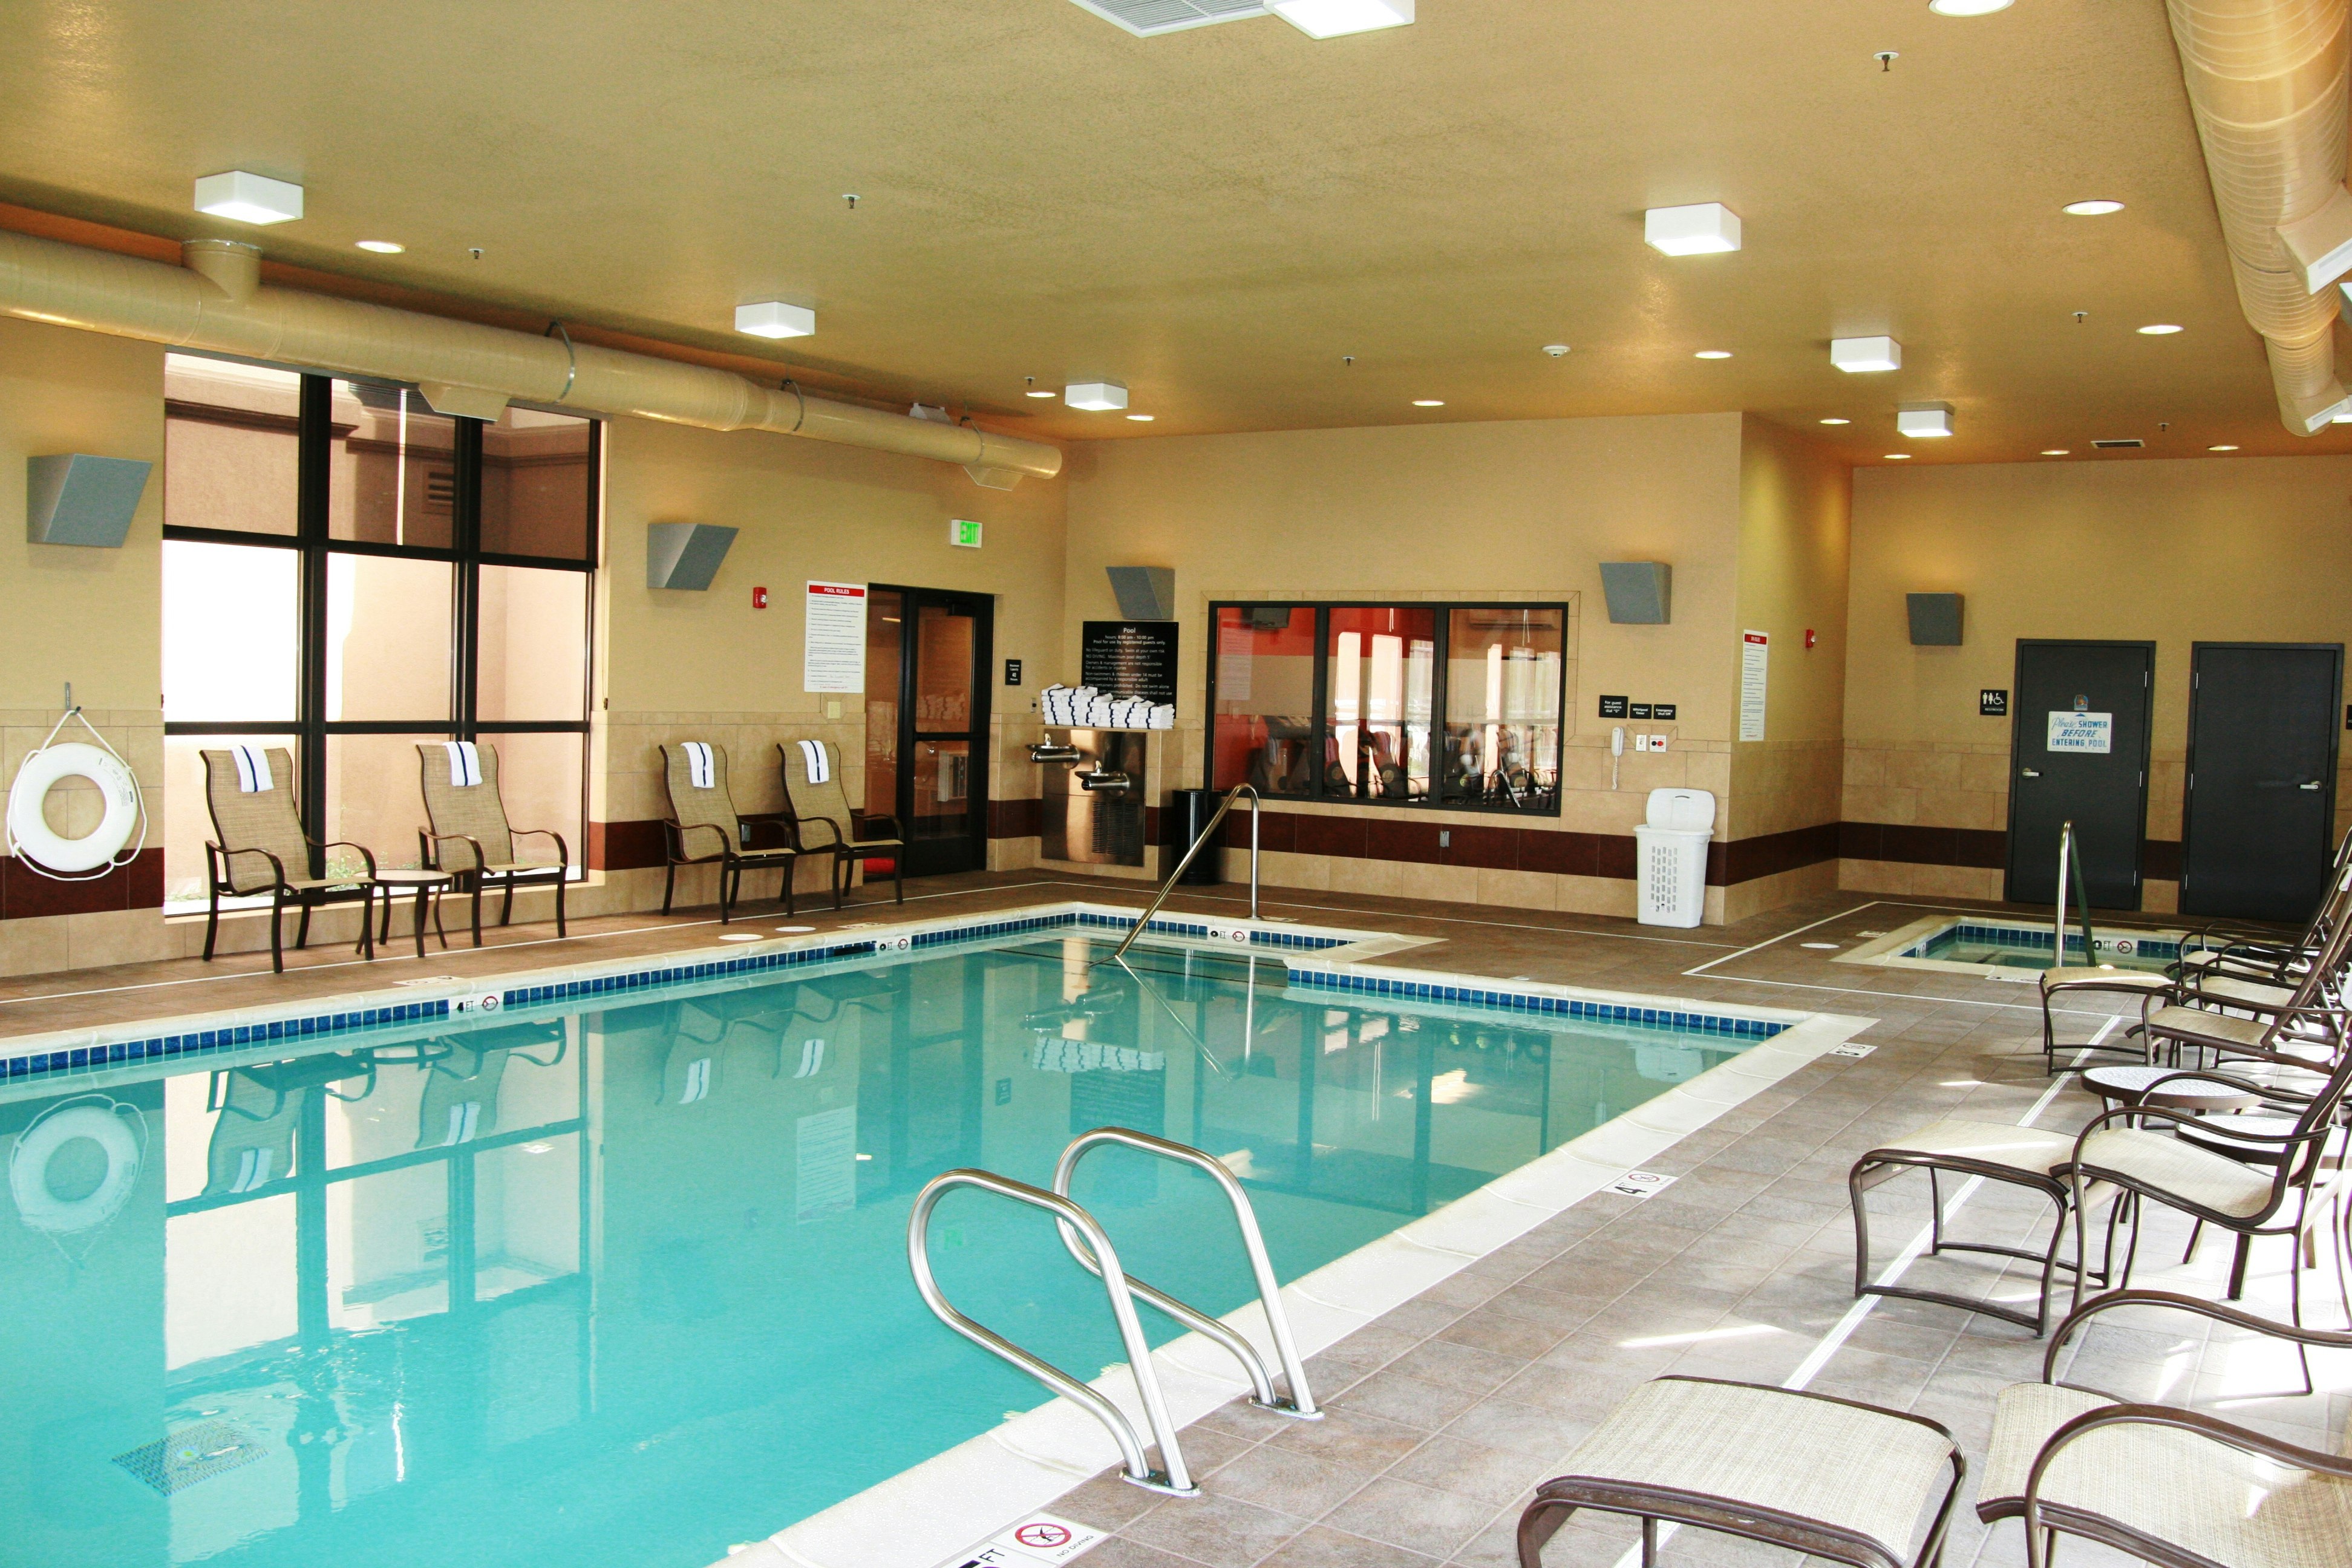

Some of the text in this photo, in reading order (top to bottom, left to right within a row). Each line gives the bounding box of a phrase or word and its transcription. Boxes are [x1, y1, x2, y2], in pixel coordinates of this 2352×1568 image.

[2061, 729, 2098, 737] BEFORE
[2052, 738, 2085, 746] ENTERING
[1615, 1186, 1647, 1194] 4
[1068, 1535, 1094, 1550] DIVING
[978, 1549, 1005, 1563] FT
